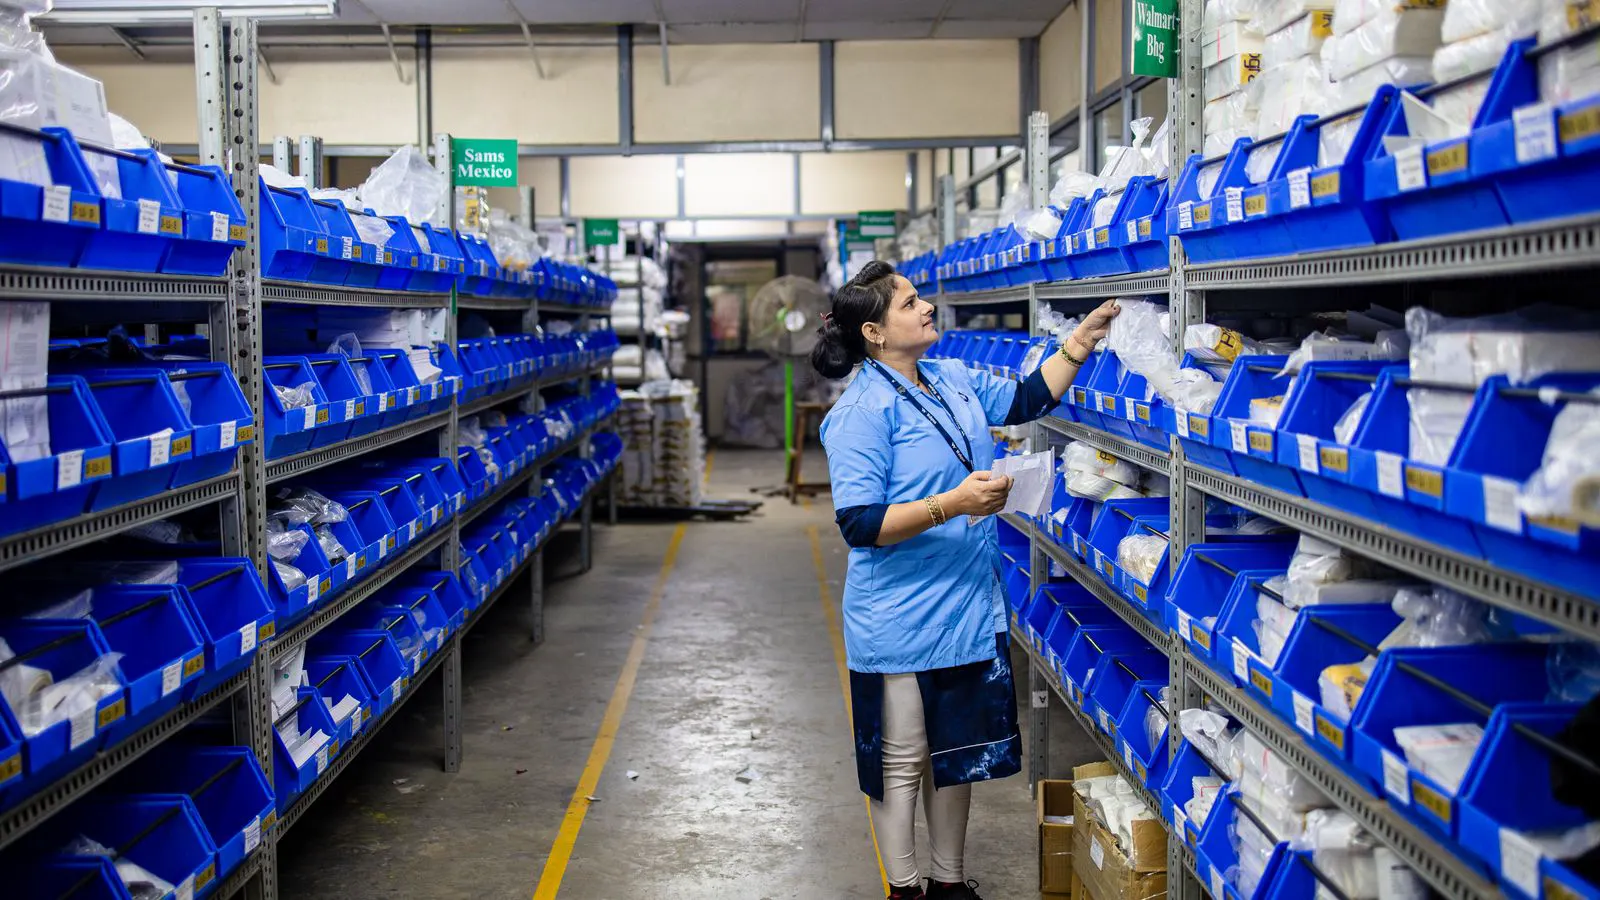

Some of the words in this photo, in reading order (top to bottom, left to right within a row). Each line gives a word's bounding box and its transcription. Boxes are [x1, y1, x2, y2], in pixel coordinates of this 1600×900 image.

[1137, 2, 1176, 30] Walmart
[1146, 33, 1165, 64] Bhg
[464, 148, 505, 163] Sams
[458, 163, 512, 178] Mexico
